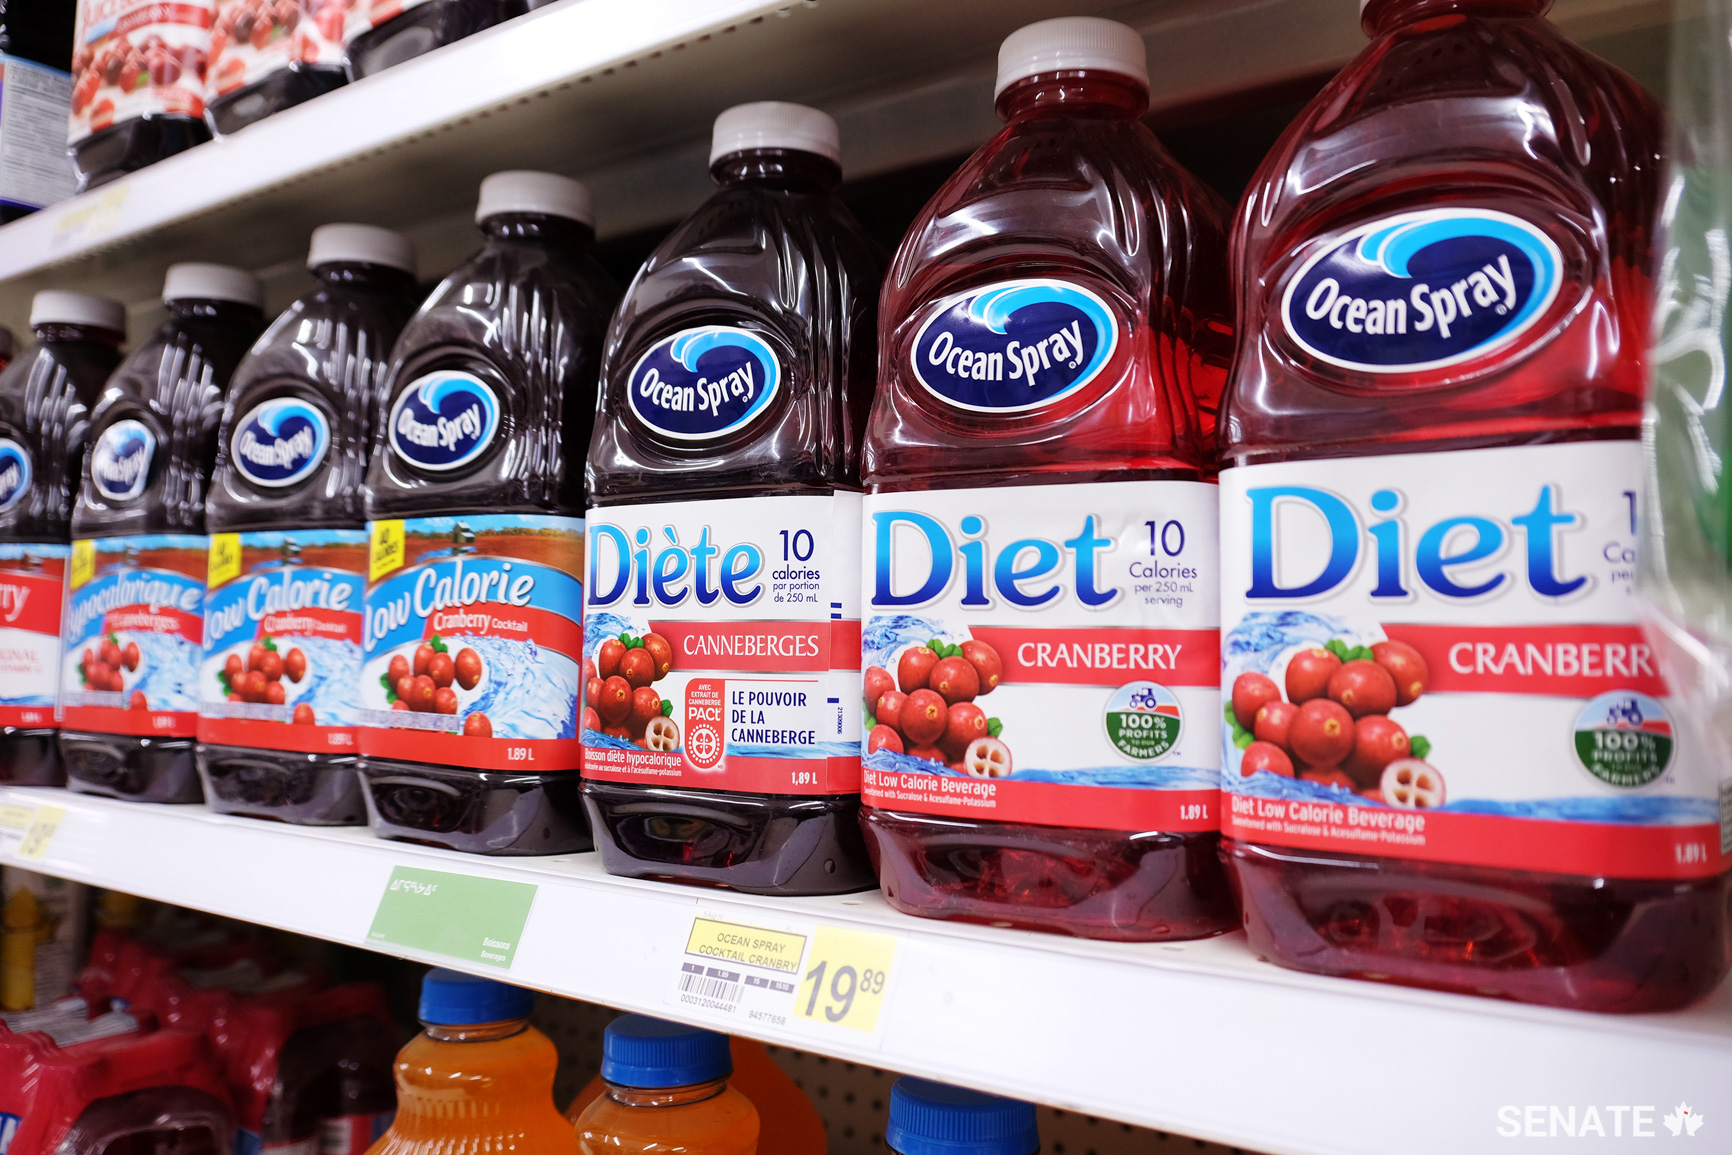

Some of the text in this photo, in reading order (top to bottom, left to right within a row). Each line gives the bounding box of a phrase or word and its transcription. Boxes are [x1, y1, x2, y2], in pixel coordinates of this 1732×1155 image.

[1305, 253, 1517, 339] Ocean Spray
[928, 320, 1084, 387] Ocean Spray
[639, 361, 755, 417] Ocean Spray
[397, 403, 481, 451] Ocean Spray
[240, 426, 313, 470] Ocean Spray
[779, 529, 814, 561] 10
[1144, 520, 1185, 556] 10
[1245, 484, 1588, 599] Diet
[587, 523, 764, 606] Diète
[870, 510, 1120, 608] Diet
[1129, 560, 1197, 578] Calories
[772, 564, 820, 580] calories
[247, 569, 353, 621] Calorie
[772, 581, 820, 593] par portion
[773, 592, 785, 603] de
[786, 593, 804, 603] 250
[1134, 584, 1152, 595] per
[1155, 581, 1178, 592] 250
[365, 556, 535, 653] Low Calorie
[1144, 594, 1183, 608] serving
[433, 610, 528, 634] Cranberry Cocktail
[683, 634, 819, 657] CANNEBERGES
[1016, 641, 1182, 670] CRANBERRY
[1449, 641, 1657, 678] CRANBERR
[732, 690, 807, 707] LE POUVOIR
[732, 709, 765, 724] DE LA
[1119, 713, 1167, 729] 100%
[731, 728, 816, 745] CANNEBERGE
[1118, 728, 1168, 739] PROFITS
[507, 747, 535, 761] 1.89 L
[584, 748, 682, 768] Boisson diète hypocalorique
[1117, 739, 1170, 758] FARMERS
[812, 772, 818, 785] L
[864, 770, 997, 799] Diet Low Calorie Beverage
[1180, 804, 1201, 820] 1.89
[1231, 795, 1426, 834] Diet Low Calorie Beverage
[482, 936, 511, 950] Boissons
[717, 932, 787, 954] OCEAN SPRAY
[480, 950, 506, 962] Beverages
[698, 944, 798, 972] COCKTAIL CRANBRY
[804, 960, 886, 1023] 19 89
